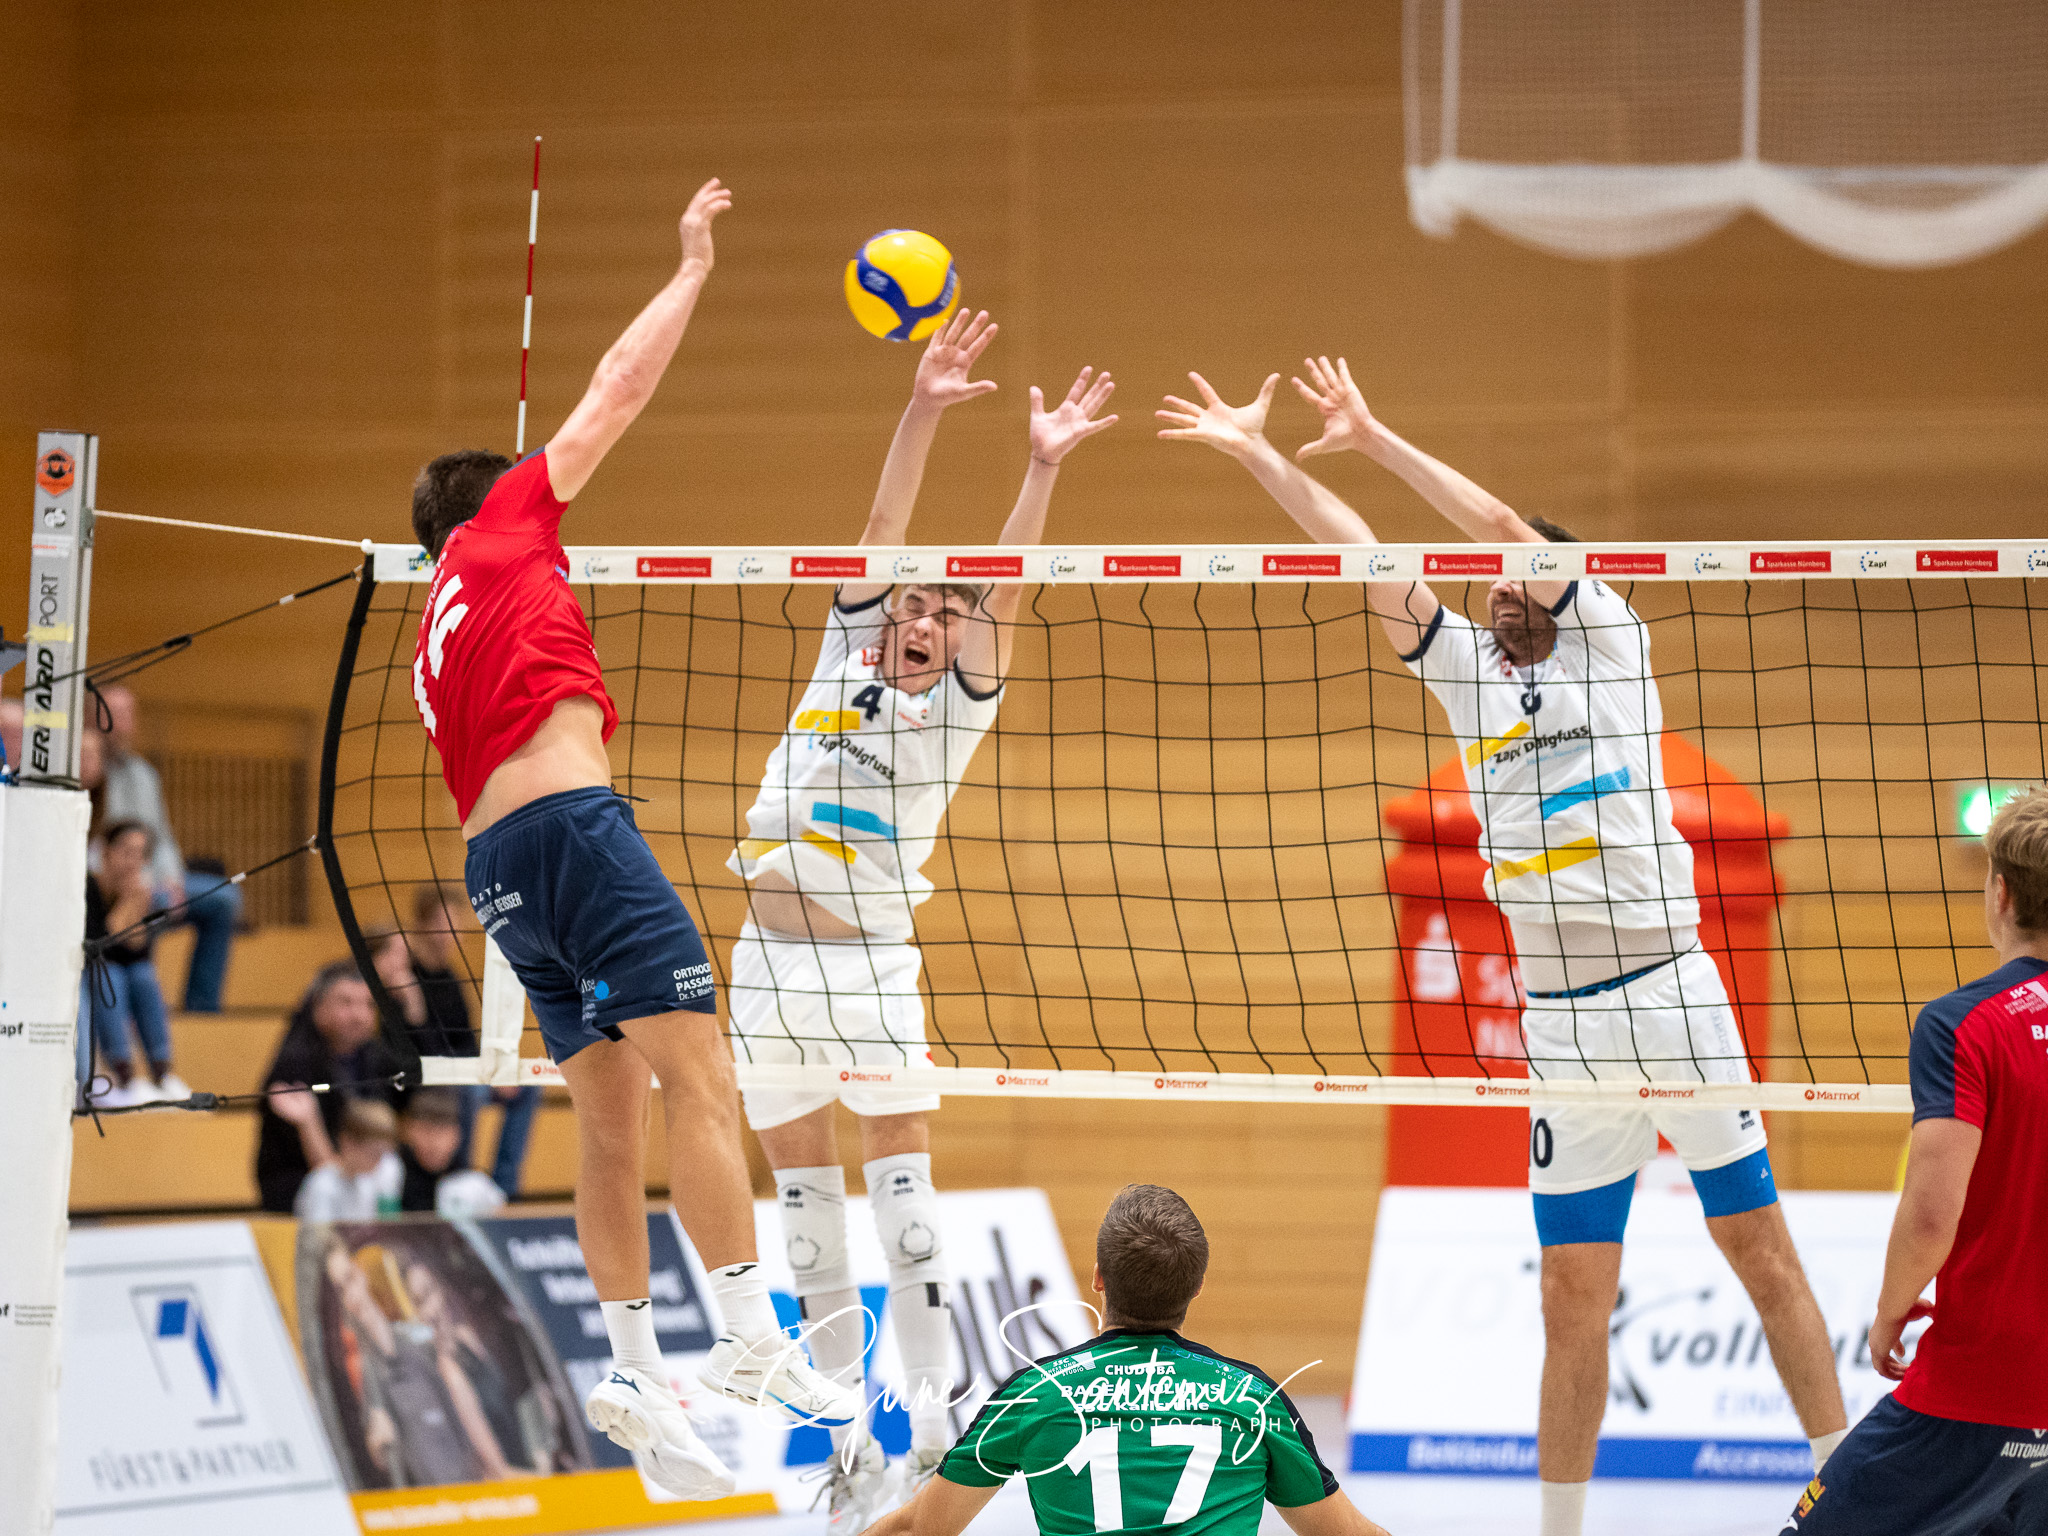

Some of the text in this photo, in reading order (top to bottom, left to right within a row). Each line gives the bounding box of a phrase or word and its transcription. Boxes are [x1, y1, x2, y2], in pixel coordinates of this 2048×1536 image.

[1216, 564, 1235, 572] Zapf
[1279, 563, 1307, 571] Sparkasse
[1376, 563, 1395, 571] Zapf
[1440, 562, 1498, 570] Sparkasse Nürnberg
[1539, 562, 1557, 570] Zapf
[1602, 562, 1661, 570] Sparkasse Nürnberg
[1766, 560, 1826, 568] Sparkasse Nürnberg
[1868, 560, 1887, 568] Zapf
[1933, 559, 1993, 567] Sparkasse Nürnberg
[2035, 559, 2048, 567] Zap
[1058, 565, 1076, 573] Zapf
[38, 573, 58, 628] PORT
[852, 684, 885, 722] 4
[31, 648, 54, 773] ERARD
[1523, 725, 1589, 754] Daigfuss
[678, 992, 690, 1001] Dr.
[690, 990, 697, 999] S.
[0, 1021, 24, 1038] apf
[851, 1073, 892, 1082] Marmot
[1007, 1076, 1049, 1086] Marmot
[1165, 1079, 1208, 1089] Marmot
[1325, 1083, 1368, 1092] Marmot
[1487, 1086, 1531, 1096] Marmot
[1650, 1088, 1695, 1098] Marmot
[1816, 1090, 1860, 1101] Marmot
[1529, 1117, 1553, 1168] 0
[1104, 1364, 1176, 1376] CHUDOBA
[1063, 1424, 1223, 1533] 17
